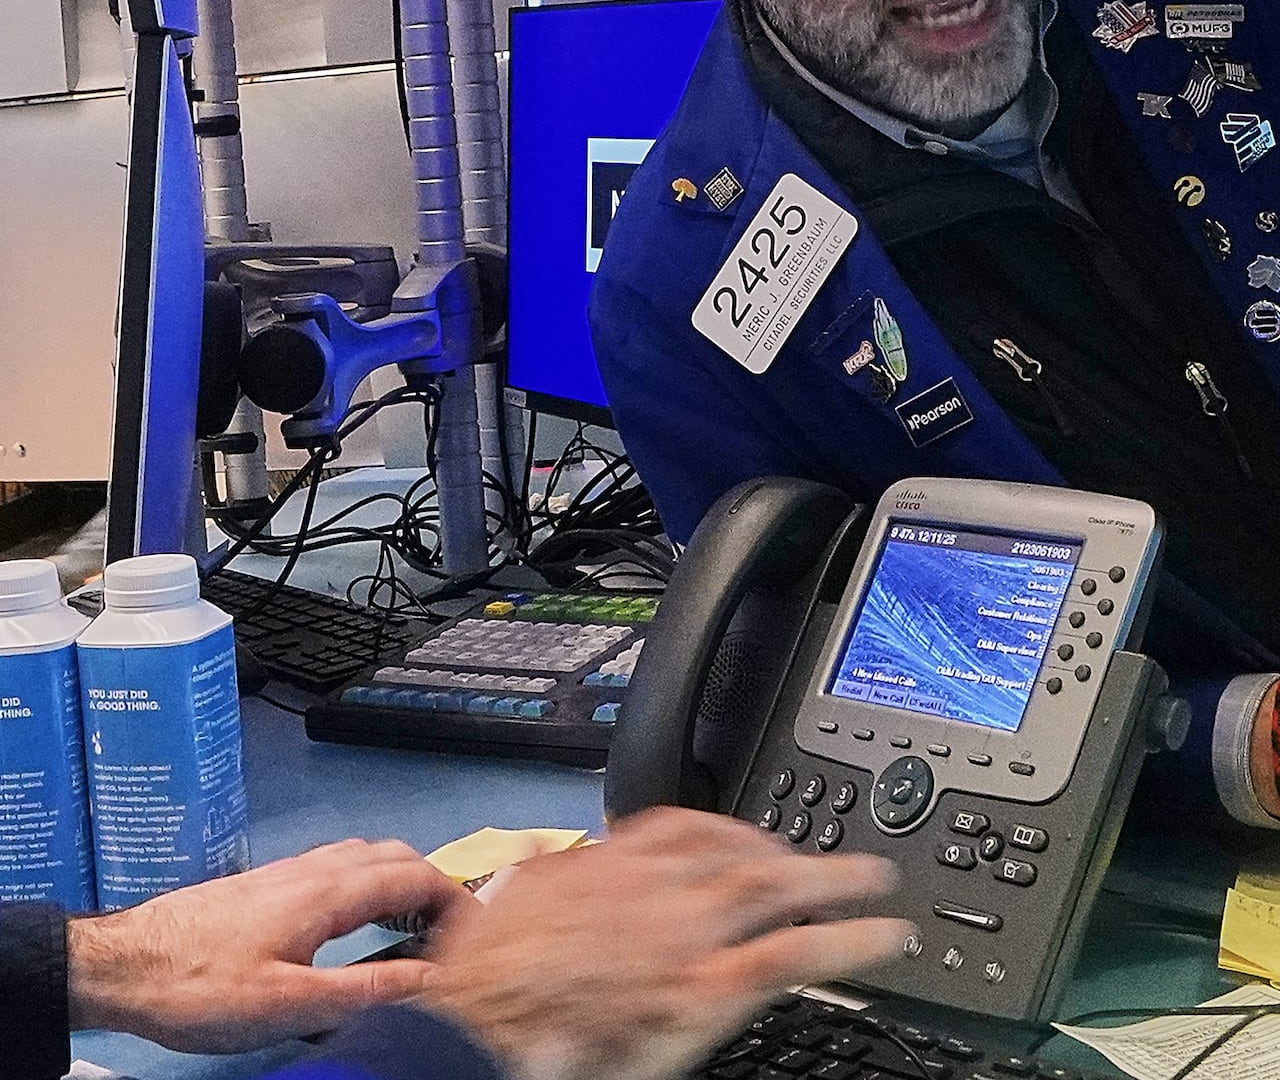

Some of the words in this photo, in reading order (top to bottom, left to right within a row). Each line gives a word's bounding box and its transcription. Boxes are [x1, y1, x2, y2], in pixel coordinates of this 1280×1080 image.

[713, 195, 807, 329] 2425
[742, 305, 771, 342] MERIC
[778, 217, 828, 287] GREENBAUM
[763, 314, 793, 352] CITADEL
[790, 257, 829, 311] SECURITIES
[826, 234, 843, 255] LLC
[910, 396, 962, 430] Pearson
[918, 529, 957, 545] 12/11/25
[1011, 543, 1072, 560] 2123061903
[1027, 581, 1061, 595] Clearing
[977, 606, 1011, 621] Customer
[1, 697, 21, 707] DID
[88, 688, 106, 699] YOU
[107, 689, 129, 700] JUST
[130, 689, 148, 700] DID
[97, 700, 126, 711] GOOD
[126, 700, 161, 711] THING.
